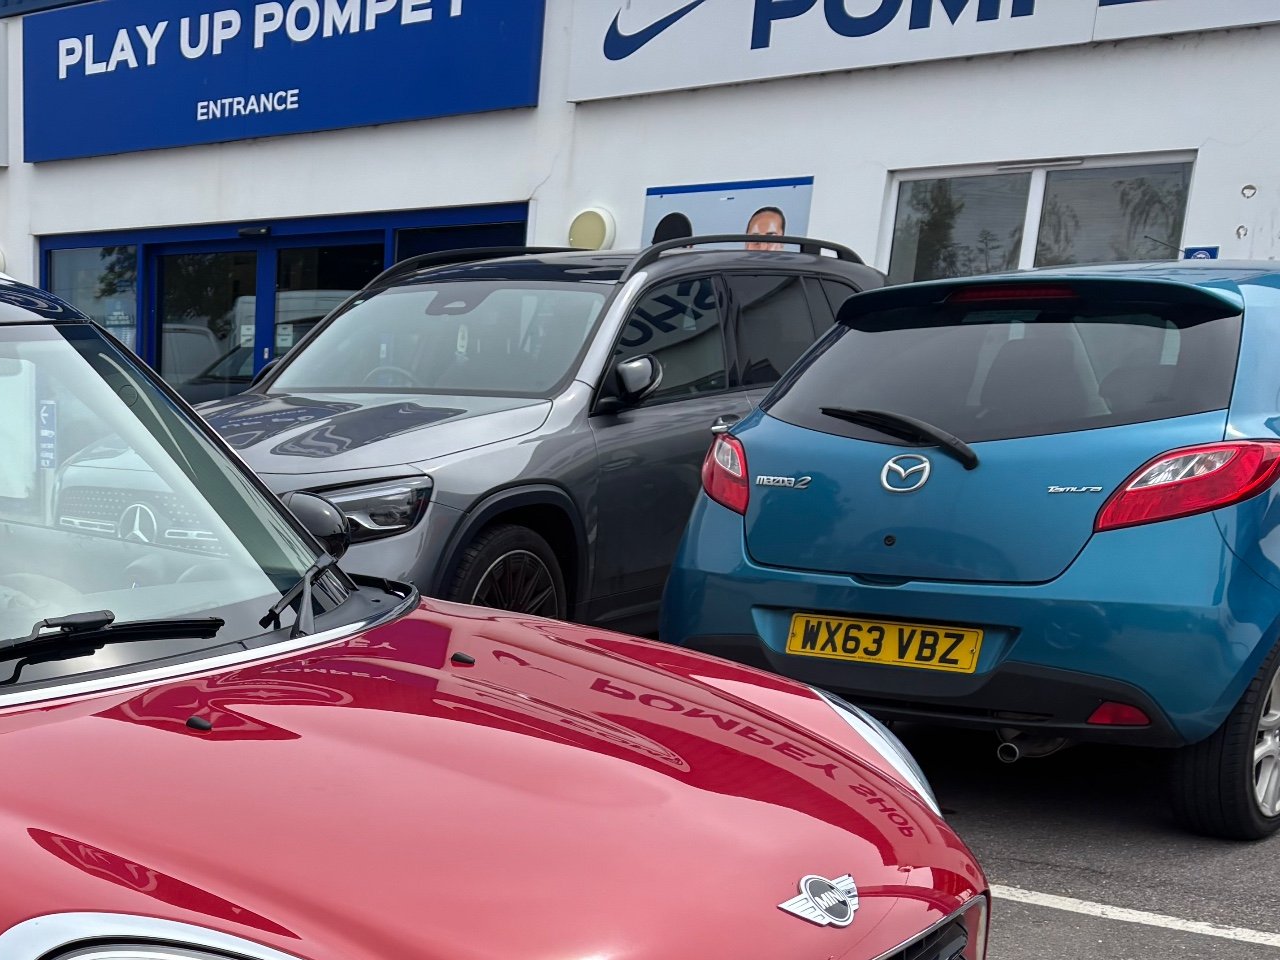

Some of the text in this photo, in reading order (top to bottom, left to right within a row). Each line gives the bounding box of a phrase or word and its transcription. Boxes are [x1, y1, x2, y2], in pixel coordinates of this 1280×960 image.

[58, 21, 169, 80] PLAY
[179, 8, 242, 60] UP
[196, 88, 300, 121] ENTRANCE
[801, 619, 965, 665] WX63 VBZ
